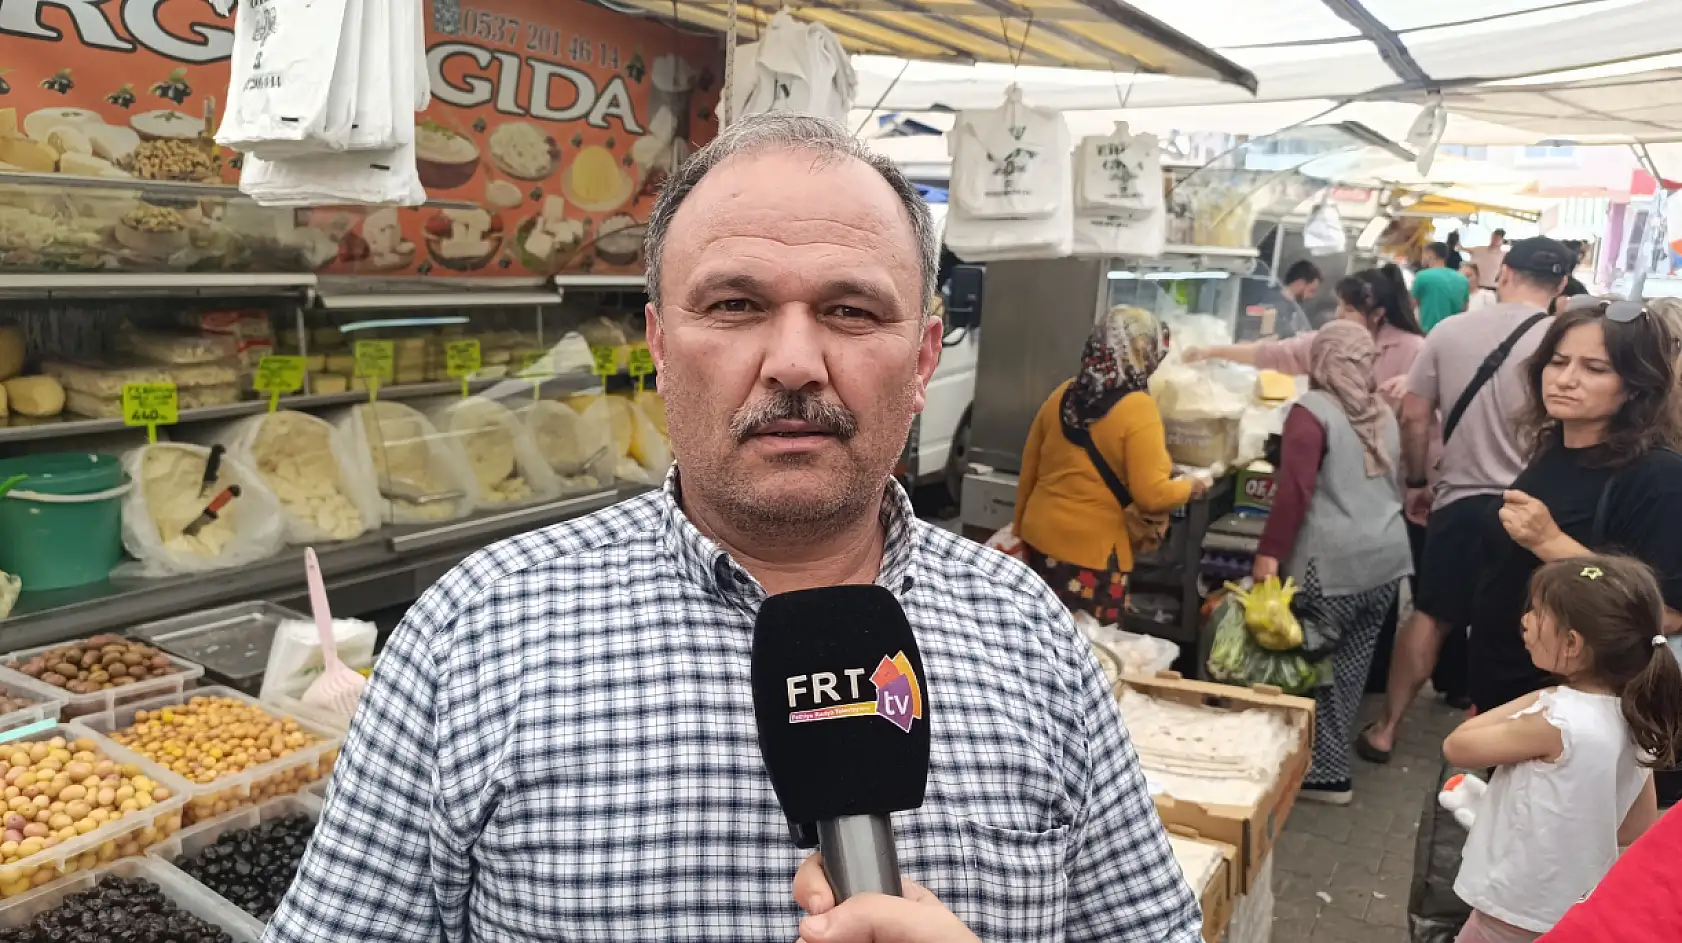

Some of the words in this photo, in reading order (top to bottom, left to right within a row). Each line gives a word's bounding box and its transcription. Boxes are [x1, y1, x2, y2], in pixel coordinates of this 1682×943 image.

[463, 8, 520, 46] 0537
[526, 22, 561, 58] 201
[567, 34, 592, 63] 46
[599, 41, 620, 70] 14
[426, 41, 645, 135] GIDA
[786, 668, 865, 708] FRT
[884, 690, 910, 716] tv
